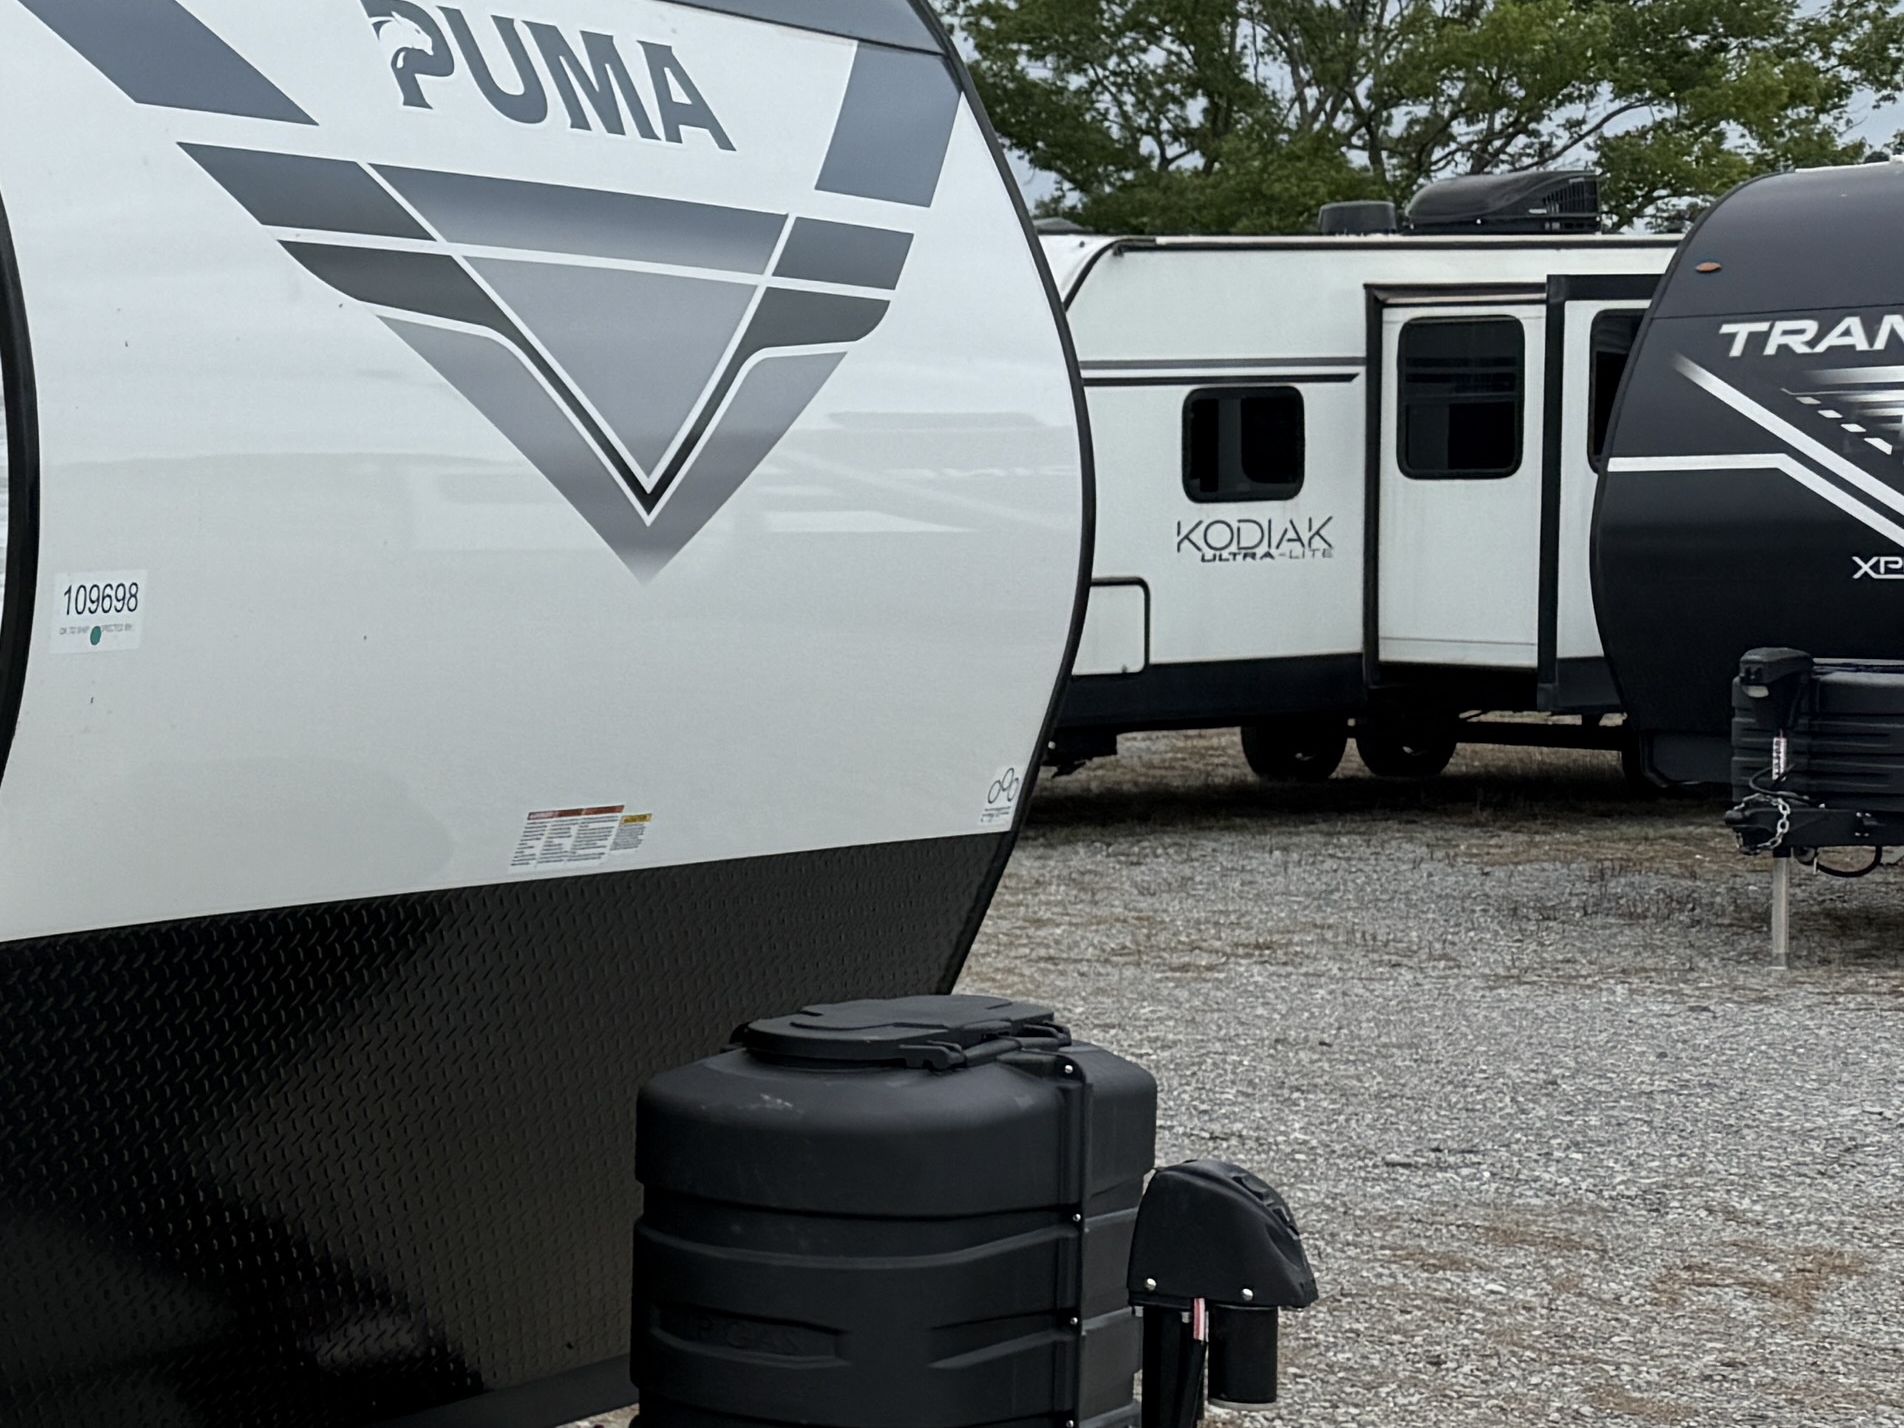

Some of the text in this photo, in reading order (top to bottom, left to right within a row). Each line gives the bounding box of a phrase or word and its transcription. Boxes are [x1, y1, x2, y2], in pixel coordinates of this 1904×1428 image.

[1177, 516, 1333, 553] KODIAK
[1201, 548, 1333, 563] ULTRA-LITE
[64, 582, 139, 616] 109698
